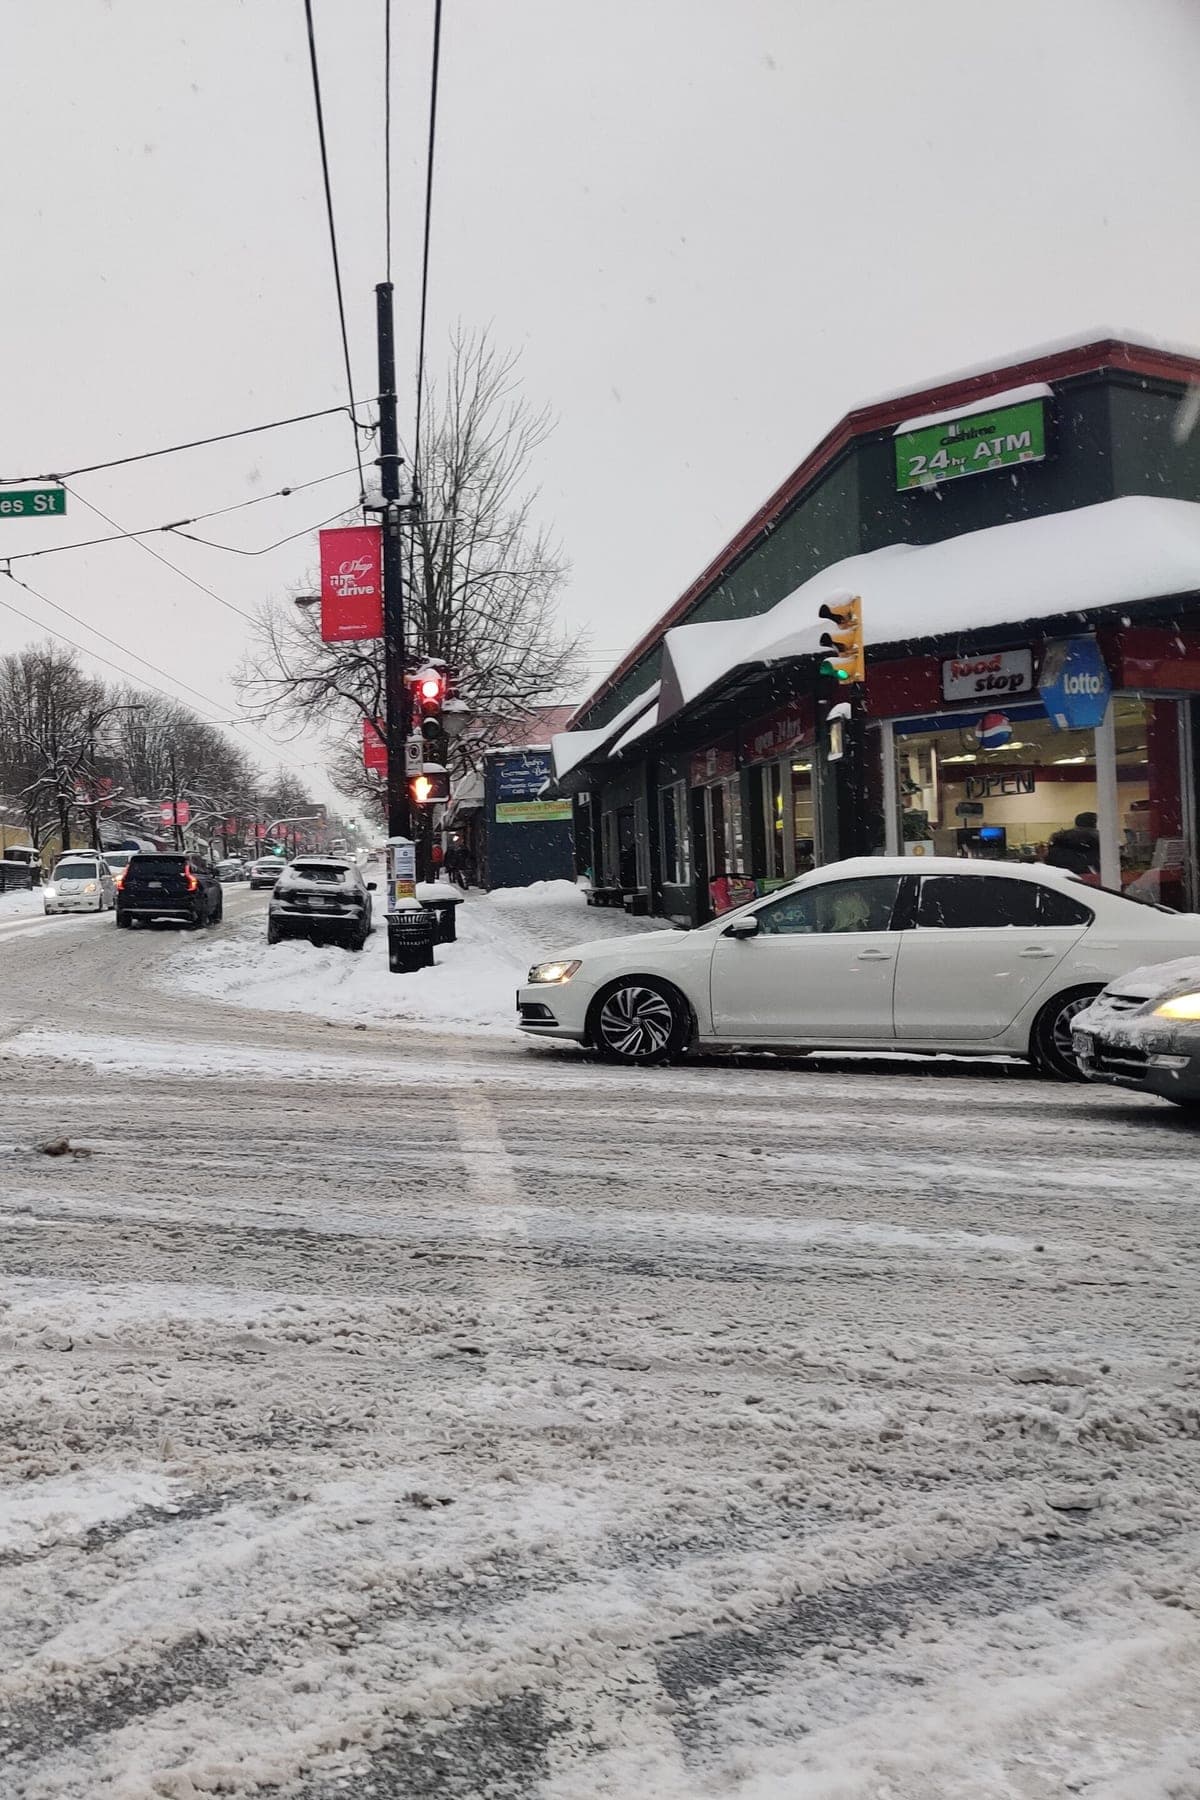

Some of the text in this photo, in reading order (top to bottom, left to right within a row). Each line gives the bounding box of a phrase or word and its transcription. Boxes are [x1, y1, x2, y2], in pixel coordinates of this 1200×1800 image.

[973, 430, 1032, 460] ATM
[33, 495, 56, 512] St
[337, 585, 375, 597] drive
[950, 654, 1003, 680] food
[974, 673, 1024, 692] stop
[965, 771, 1035, 799] OPEN
